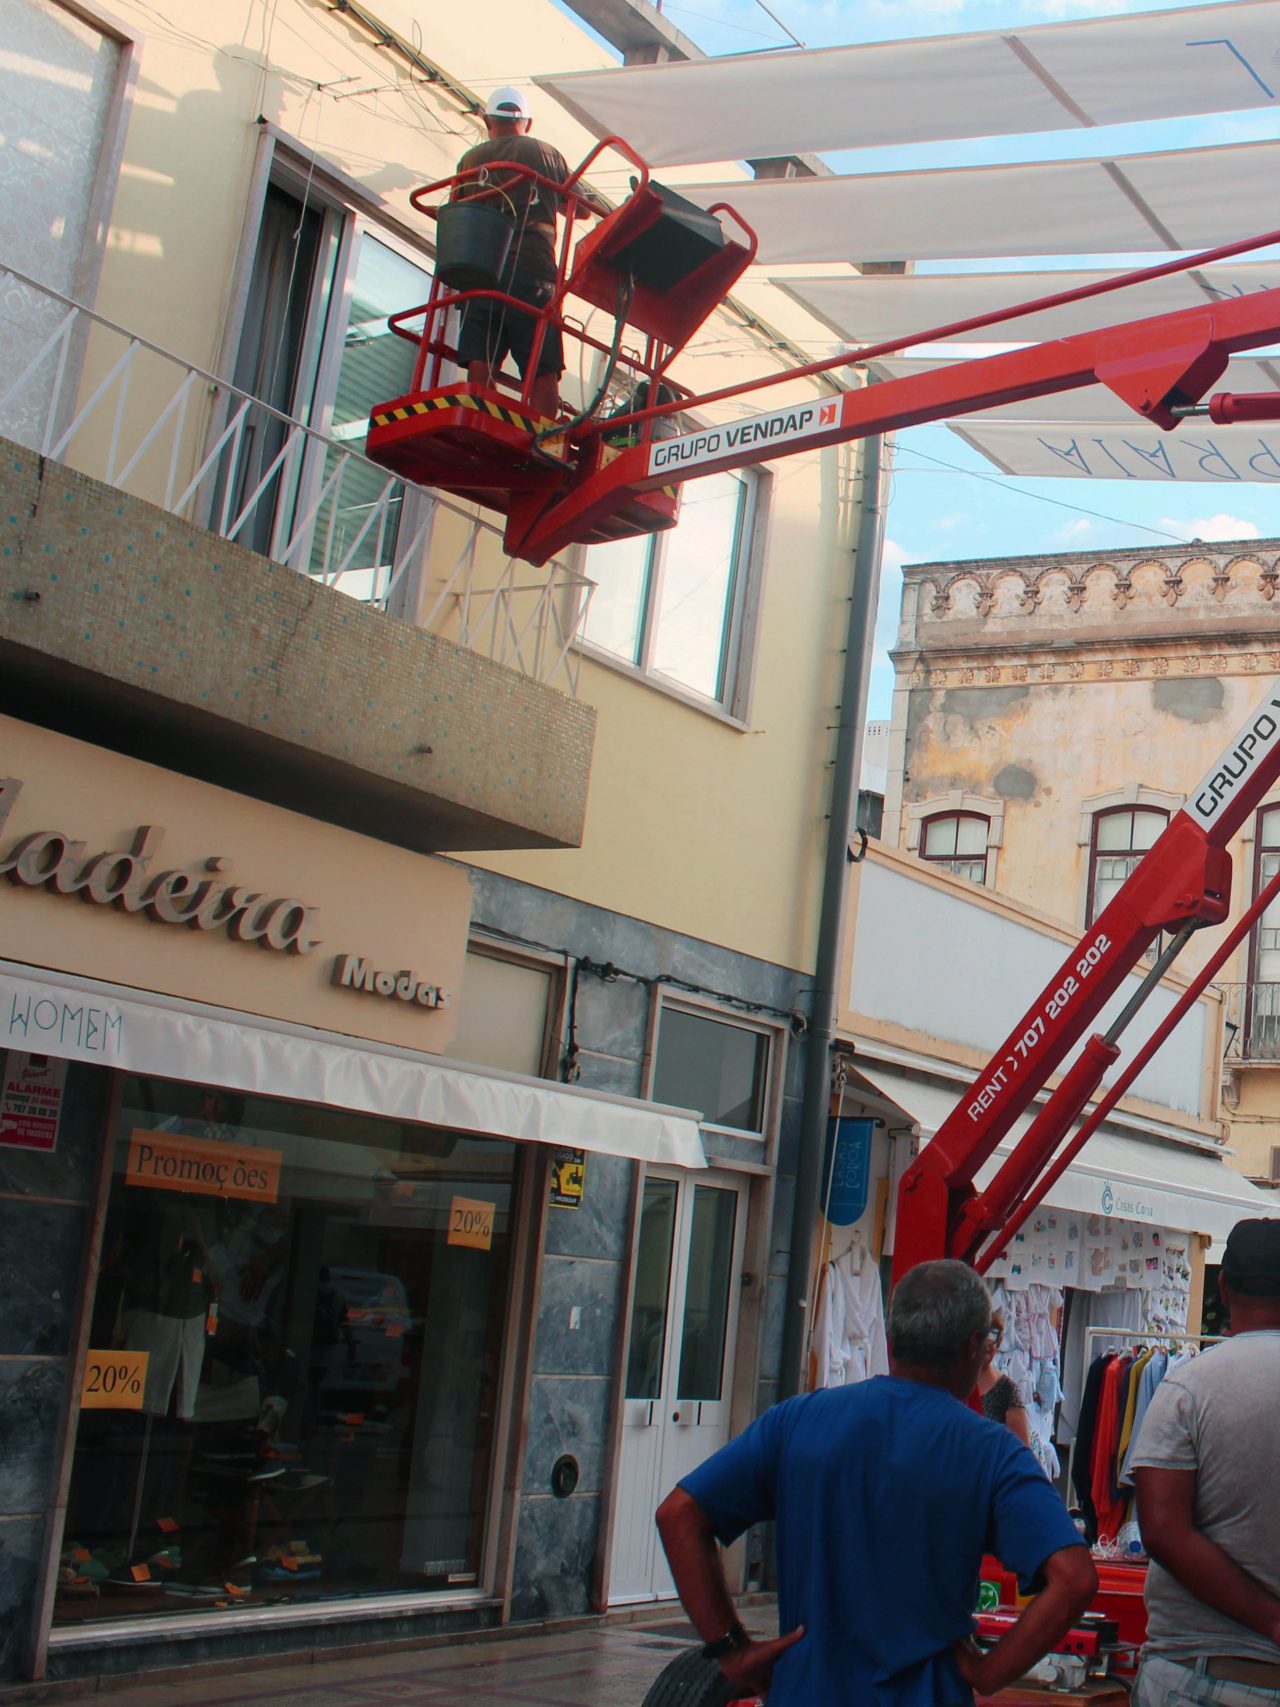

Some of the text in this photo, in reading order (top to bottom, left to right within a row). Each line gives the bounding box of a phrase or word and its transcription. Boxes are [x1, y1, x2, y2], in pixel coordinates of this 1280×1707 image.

[654, 410, 813, 466] GRUPO VENDAP
[1195, 713, 1277, 818] GRUPO
[0, 778, 323, 955] adeira
[332, 953, 452, 1012] Modas
[967, 934, 1112, 1122] RENT 707 202 202
[7, 1082, 62, 1098] ALARME
[452, 1210, 490, 1237] 20%
[86, 1365, 140, 1394] 20%
